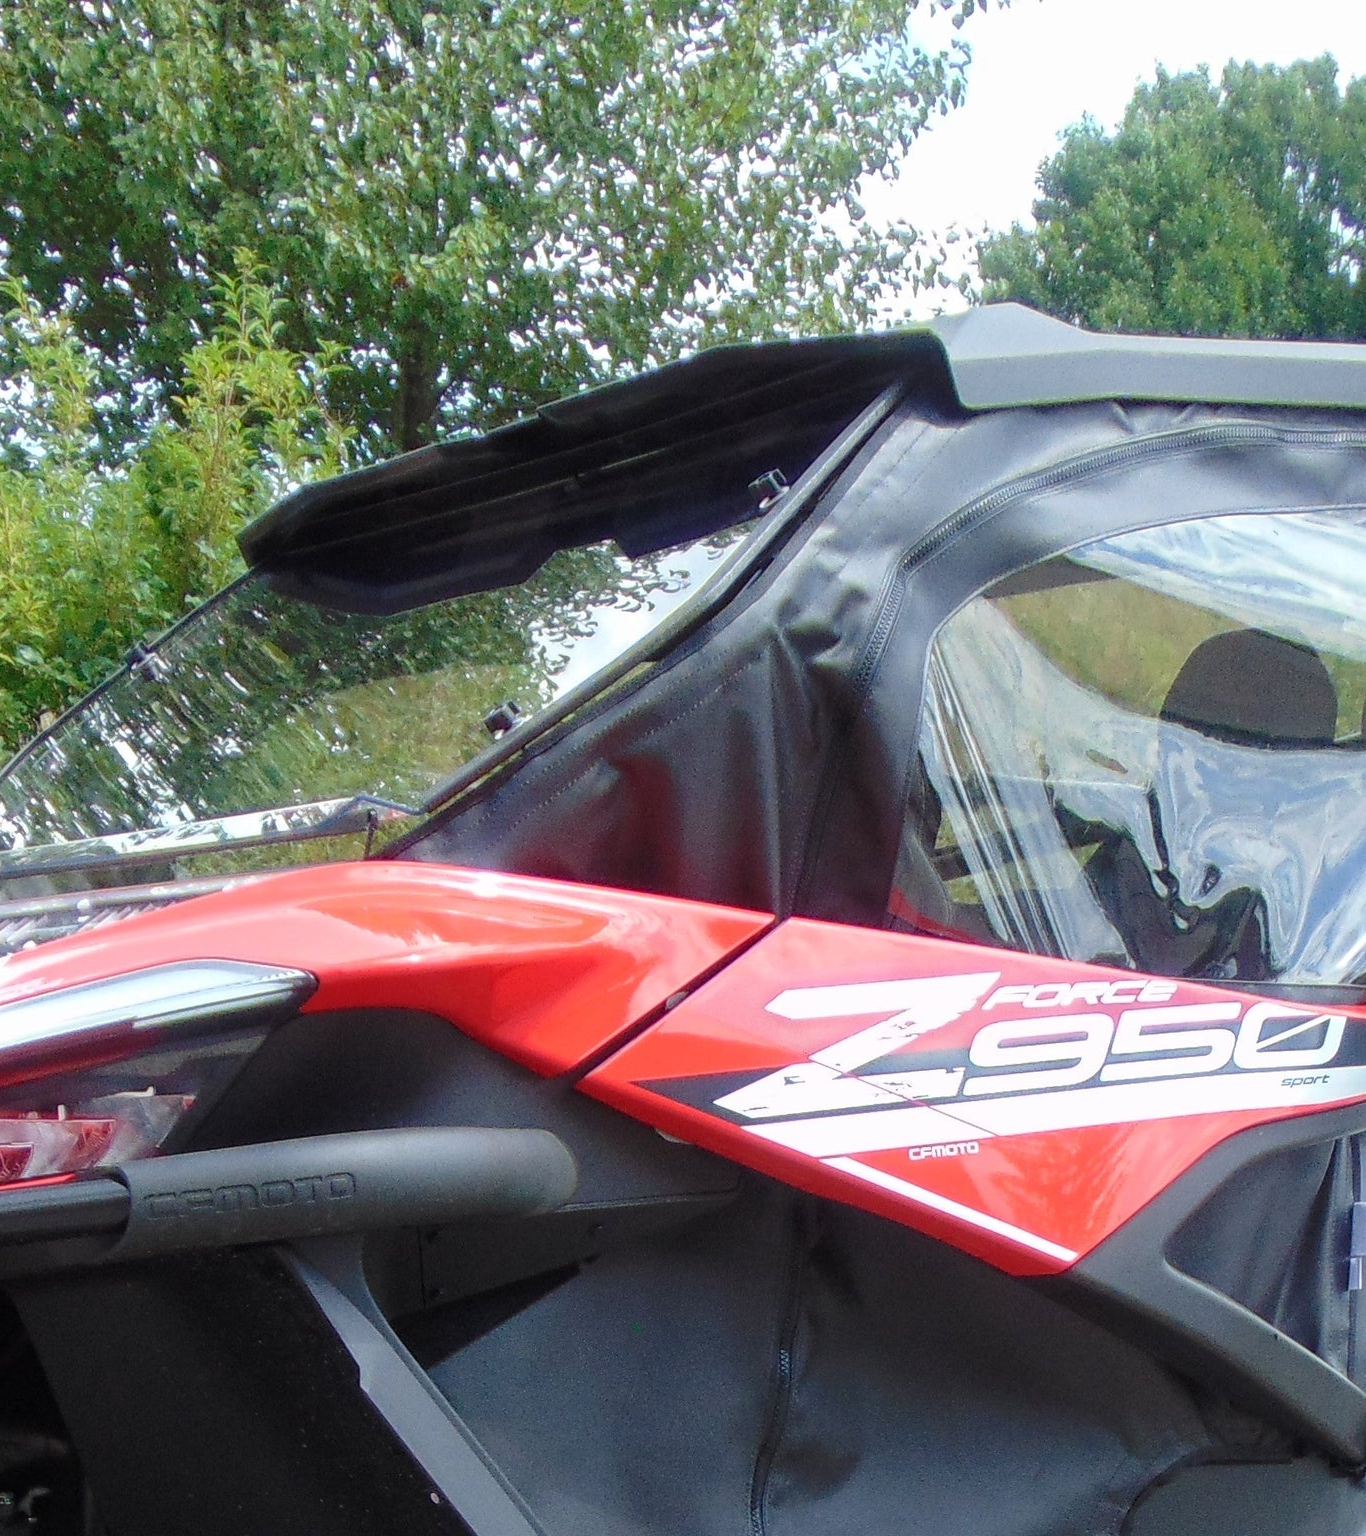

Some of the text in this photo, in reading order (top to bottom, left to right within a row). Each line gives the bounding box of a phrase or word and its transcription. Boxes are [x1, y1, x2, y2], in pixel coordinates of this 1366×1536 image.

[981, 979, 1179, 1011] FORCE
[962, 1001, 1348, 1097] 950
[1281, 1074, 1330, 1089] sport
[908, 1141, 980, 1161] CFMOTO
